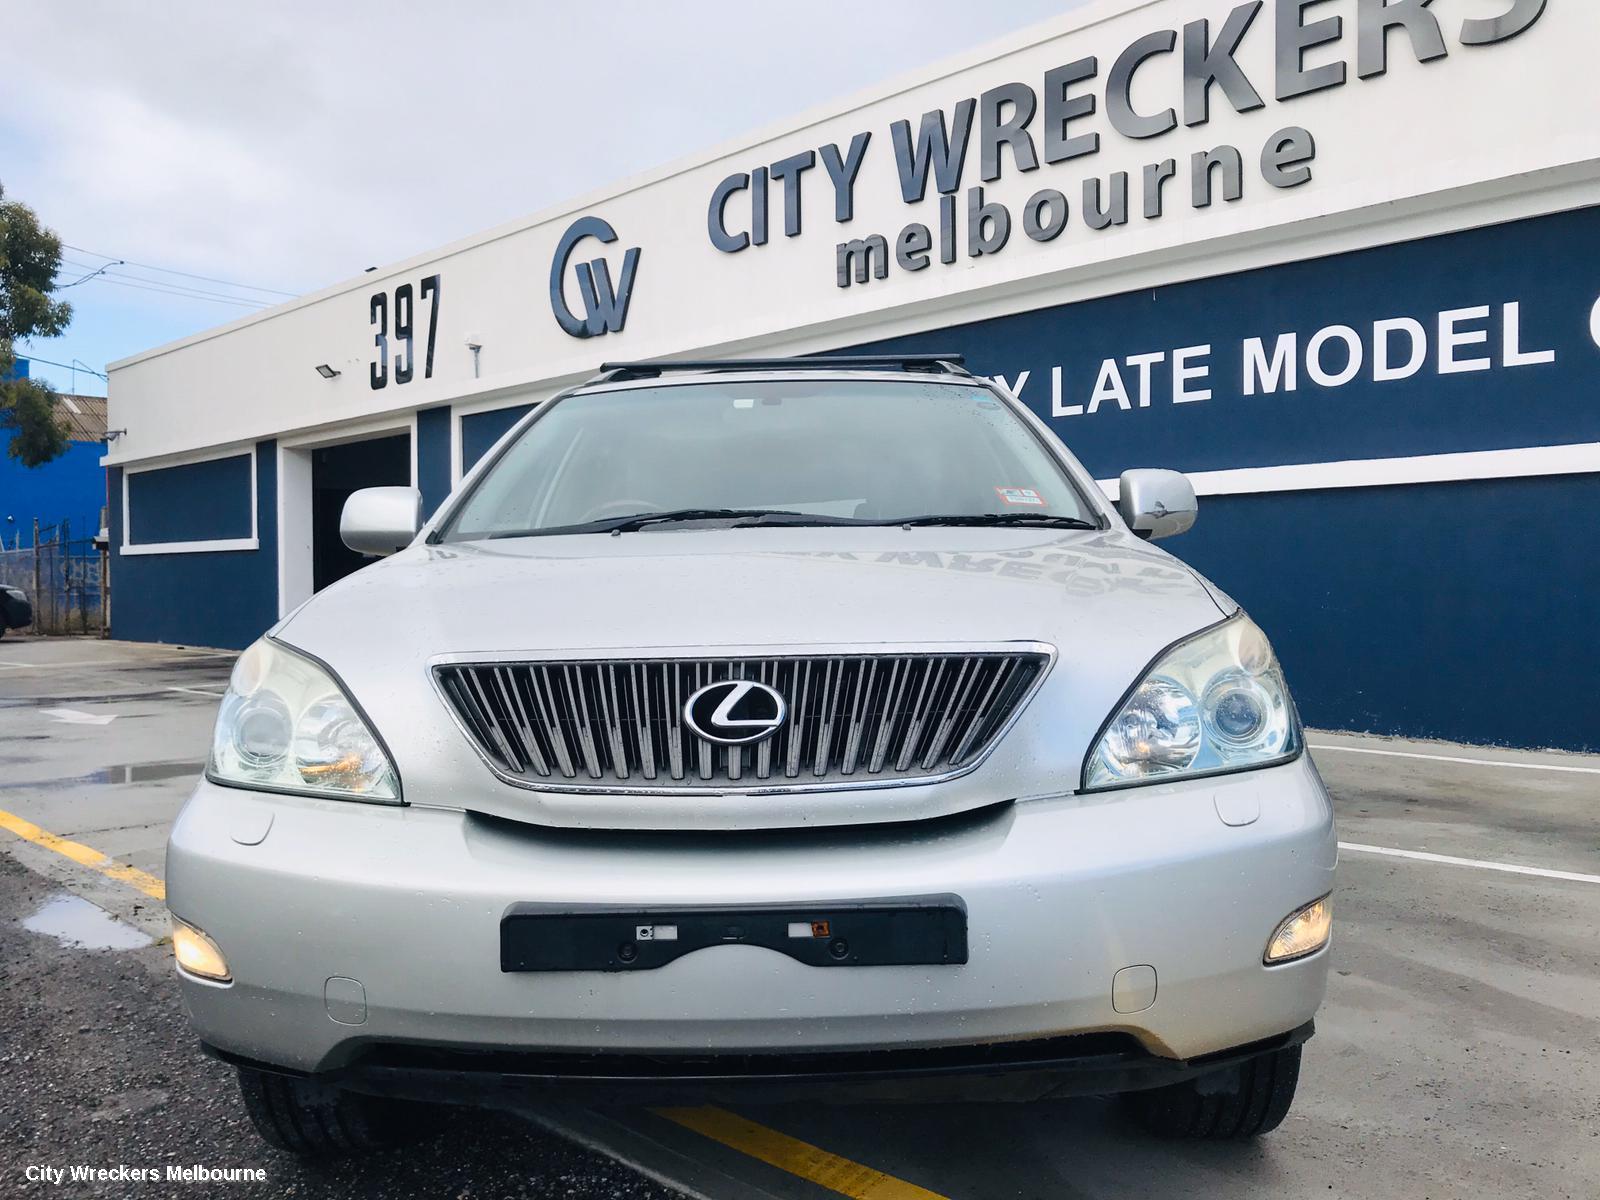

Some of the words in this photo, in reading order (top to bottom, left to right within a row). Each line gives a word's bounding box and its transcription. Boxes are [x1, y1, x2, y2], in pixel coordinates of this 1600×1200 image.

[708, 131, 872, 254] CITY
[836, 126, 1316, 288] melbourne
[370, 273, 441, 391] 397
[1052, 343, 1212, 418] LATE
[1243, 301, 1555, 397] MODEL
